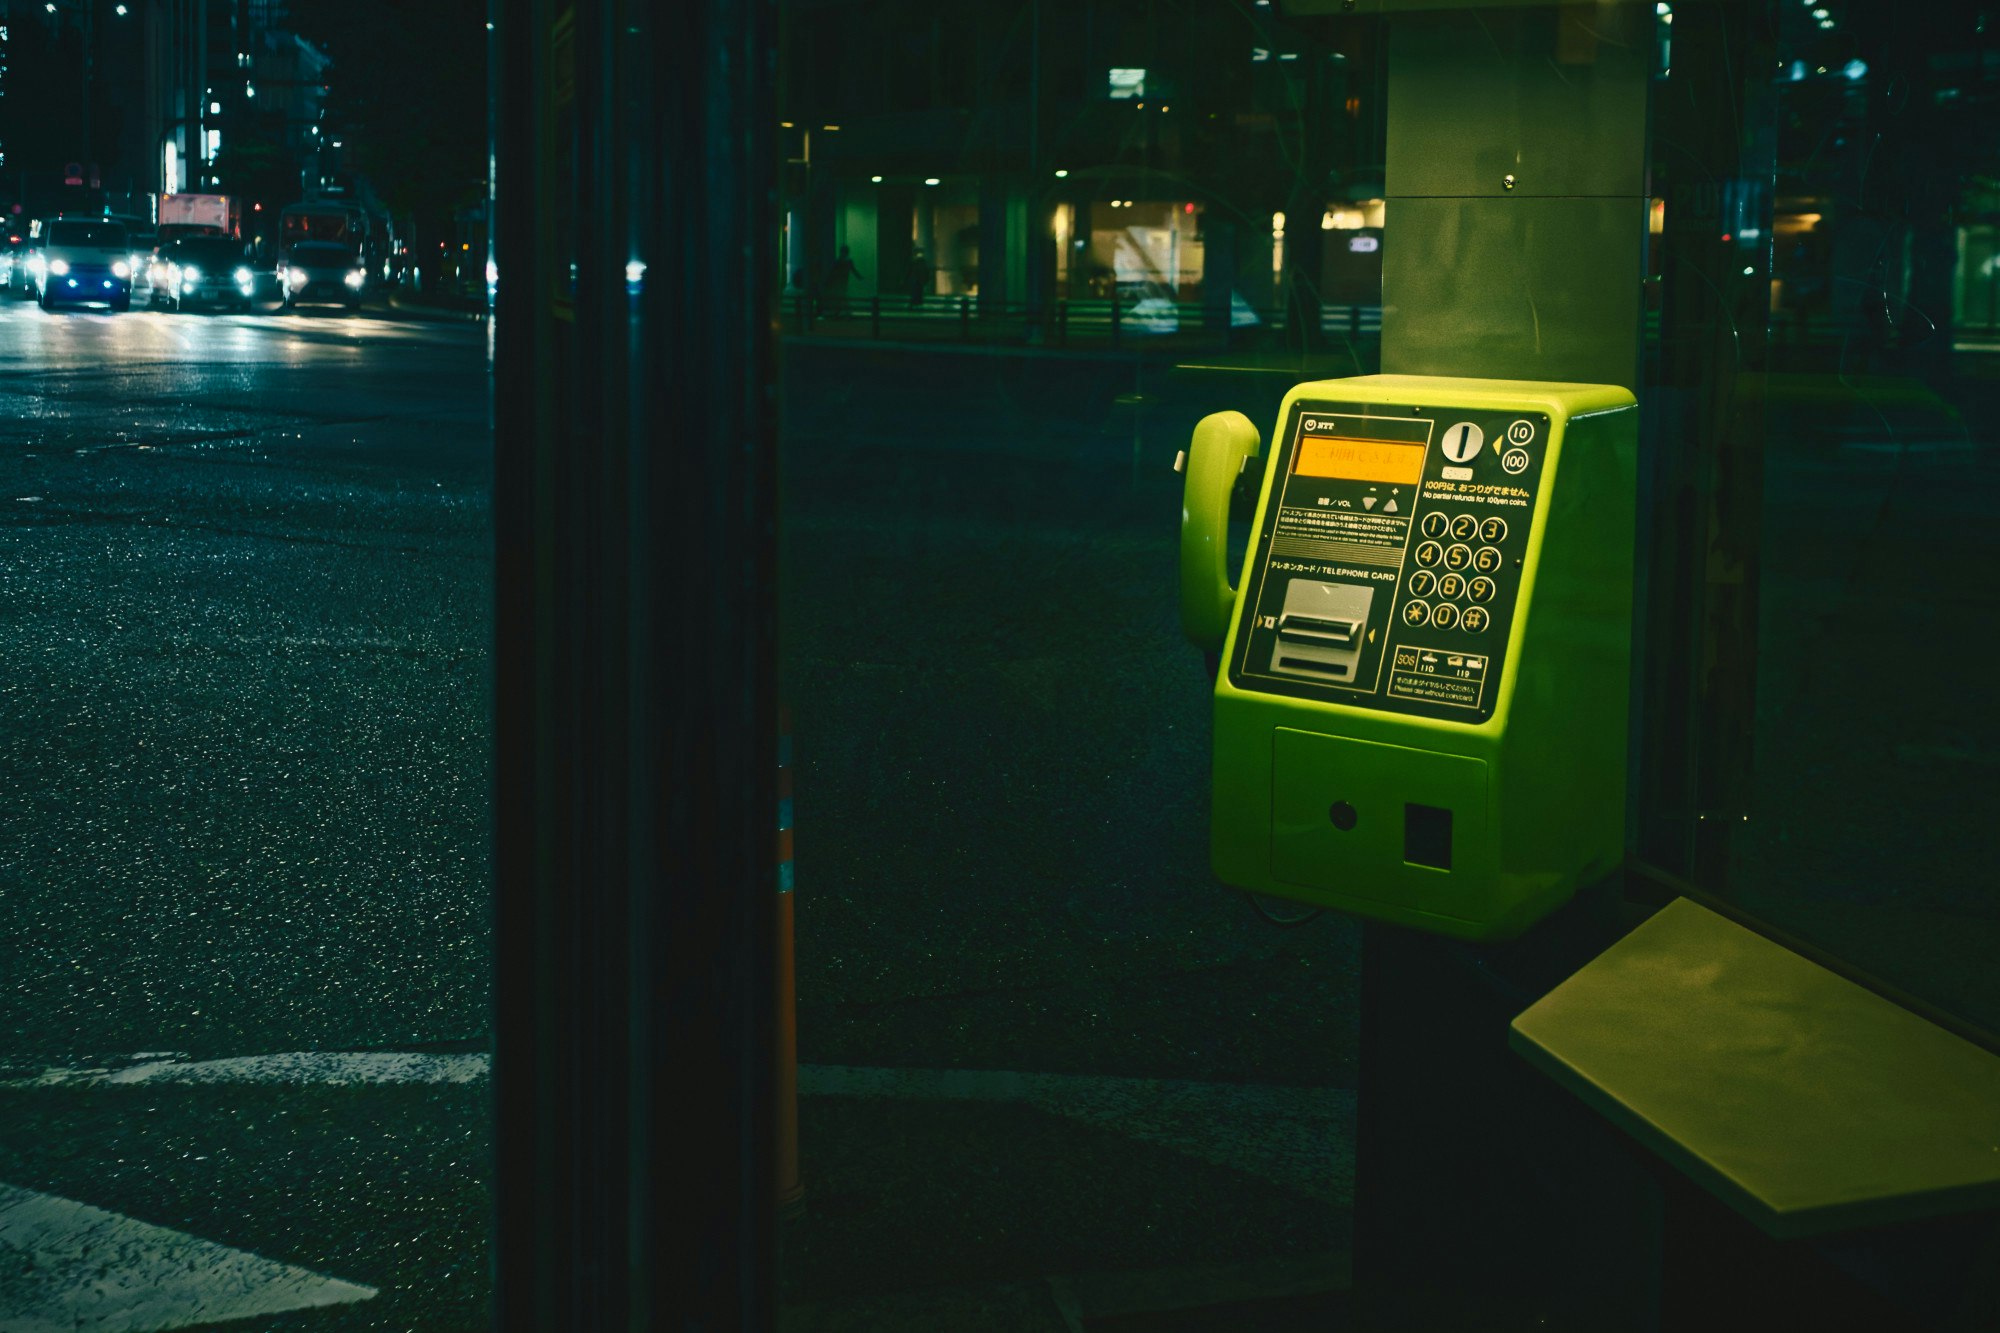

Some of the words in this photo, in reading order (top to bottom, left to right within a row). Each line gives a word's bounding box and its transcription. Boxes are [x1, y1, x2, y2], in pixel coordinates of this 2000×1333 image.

[1317, 422, 1334, 430] NTT
[1514, 427, 1527, 438] 10
[1506, 456, 1524, 467] 100
[1452, 494, 1474, 502] refunds
[1431, 517, 1437, 532] 1
[1456, 519, 1468, 535] 2
[1486, 521, 1497, 538] 3
[1421, 546, 1432, 562] 4
[1450, 548, 1462, 565] 5
[1479, 551, 1492, 569] 6
[1271, 561, 1316, 572] テレホンカード
[1322, 566, 1368, 579] TELEPHONE
[1371, 572, 1395, 581] CARD
[1417, 575, 1427, 592] 7
[1443, 577, 1456, 595] 8
[1474, 581, 1486, 598] 9
[1437, 607, 1450, 624] 0
[1397, 654, 1415, 666] SOS
[1421, 664, 1434, 672] 110
[1457, 669, 1470, 678] 119
